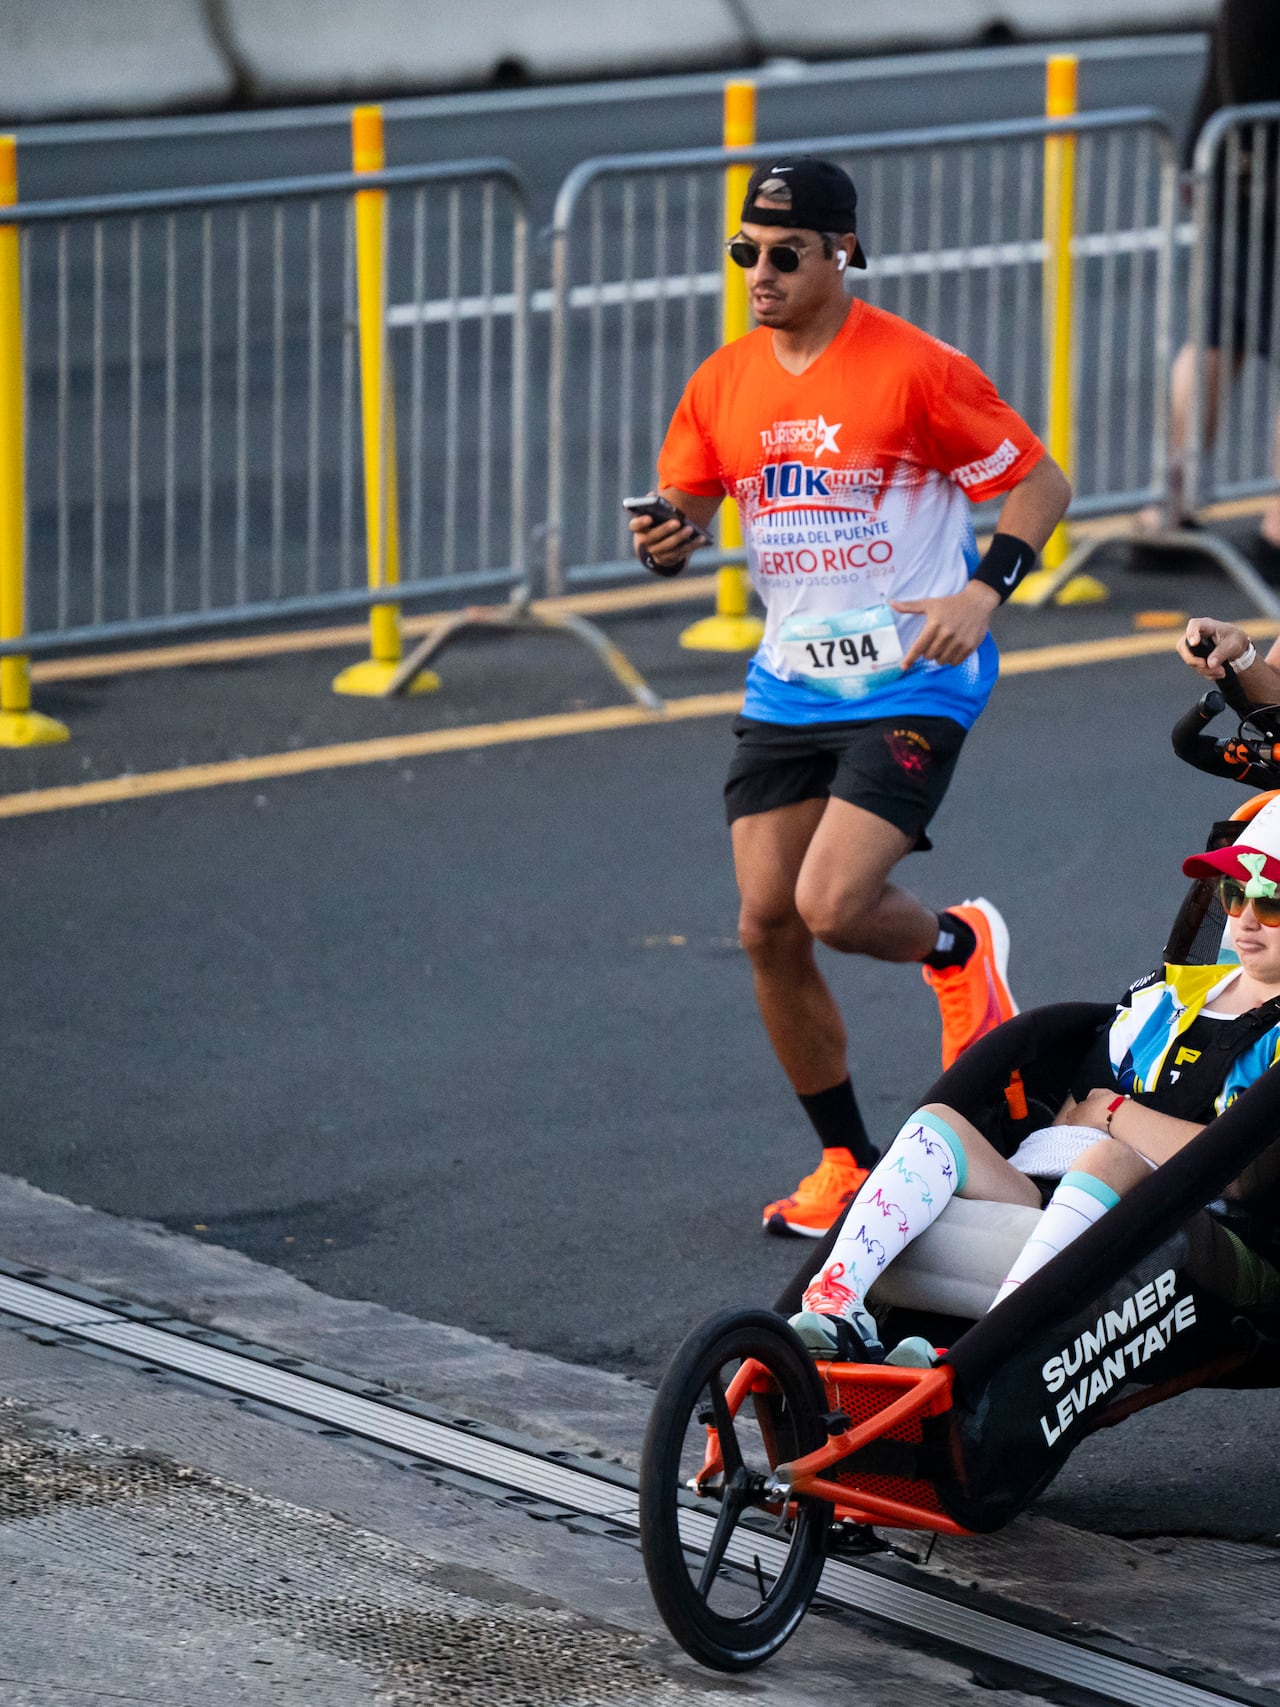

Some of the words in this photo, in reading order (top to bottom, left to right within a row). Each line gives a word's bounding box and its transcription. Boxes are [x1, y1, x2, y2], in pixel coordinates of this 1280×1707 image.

[760, 427, 816, 447] TURISMO
[763, 462, 831, 499] 10K
[832, 468, 883, 486] RUN
[808, 530, 831, 543] DEL
[834, 520, 889, 541] PUENTE
[822, 540, 893, 572] RICO
[806, 633, 879, 668] 1794
[1042, 1269, 1177, 1392] SUMMER
[1040, 1294, 1197, 1447] LEVANTATE
